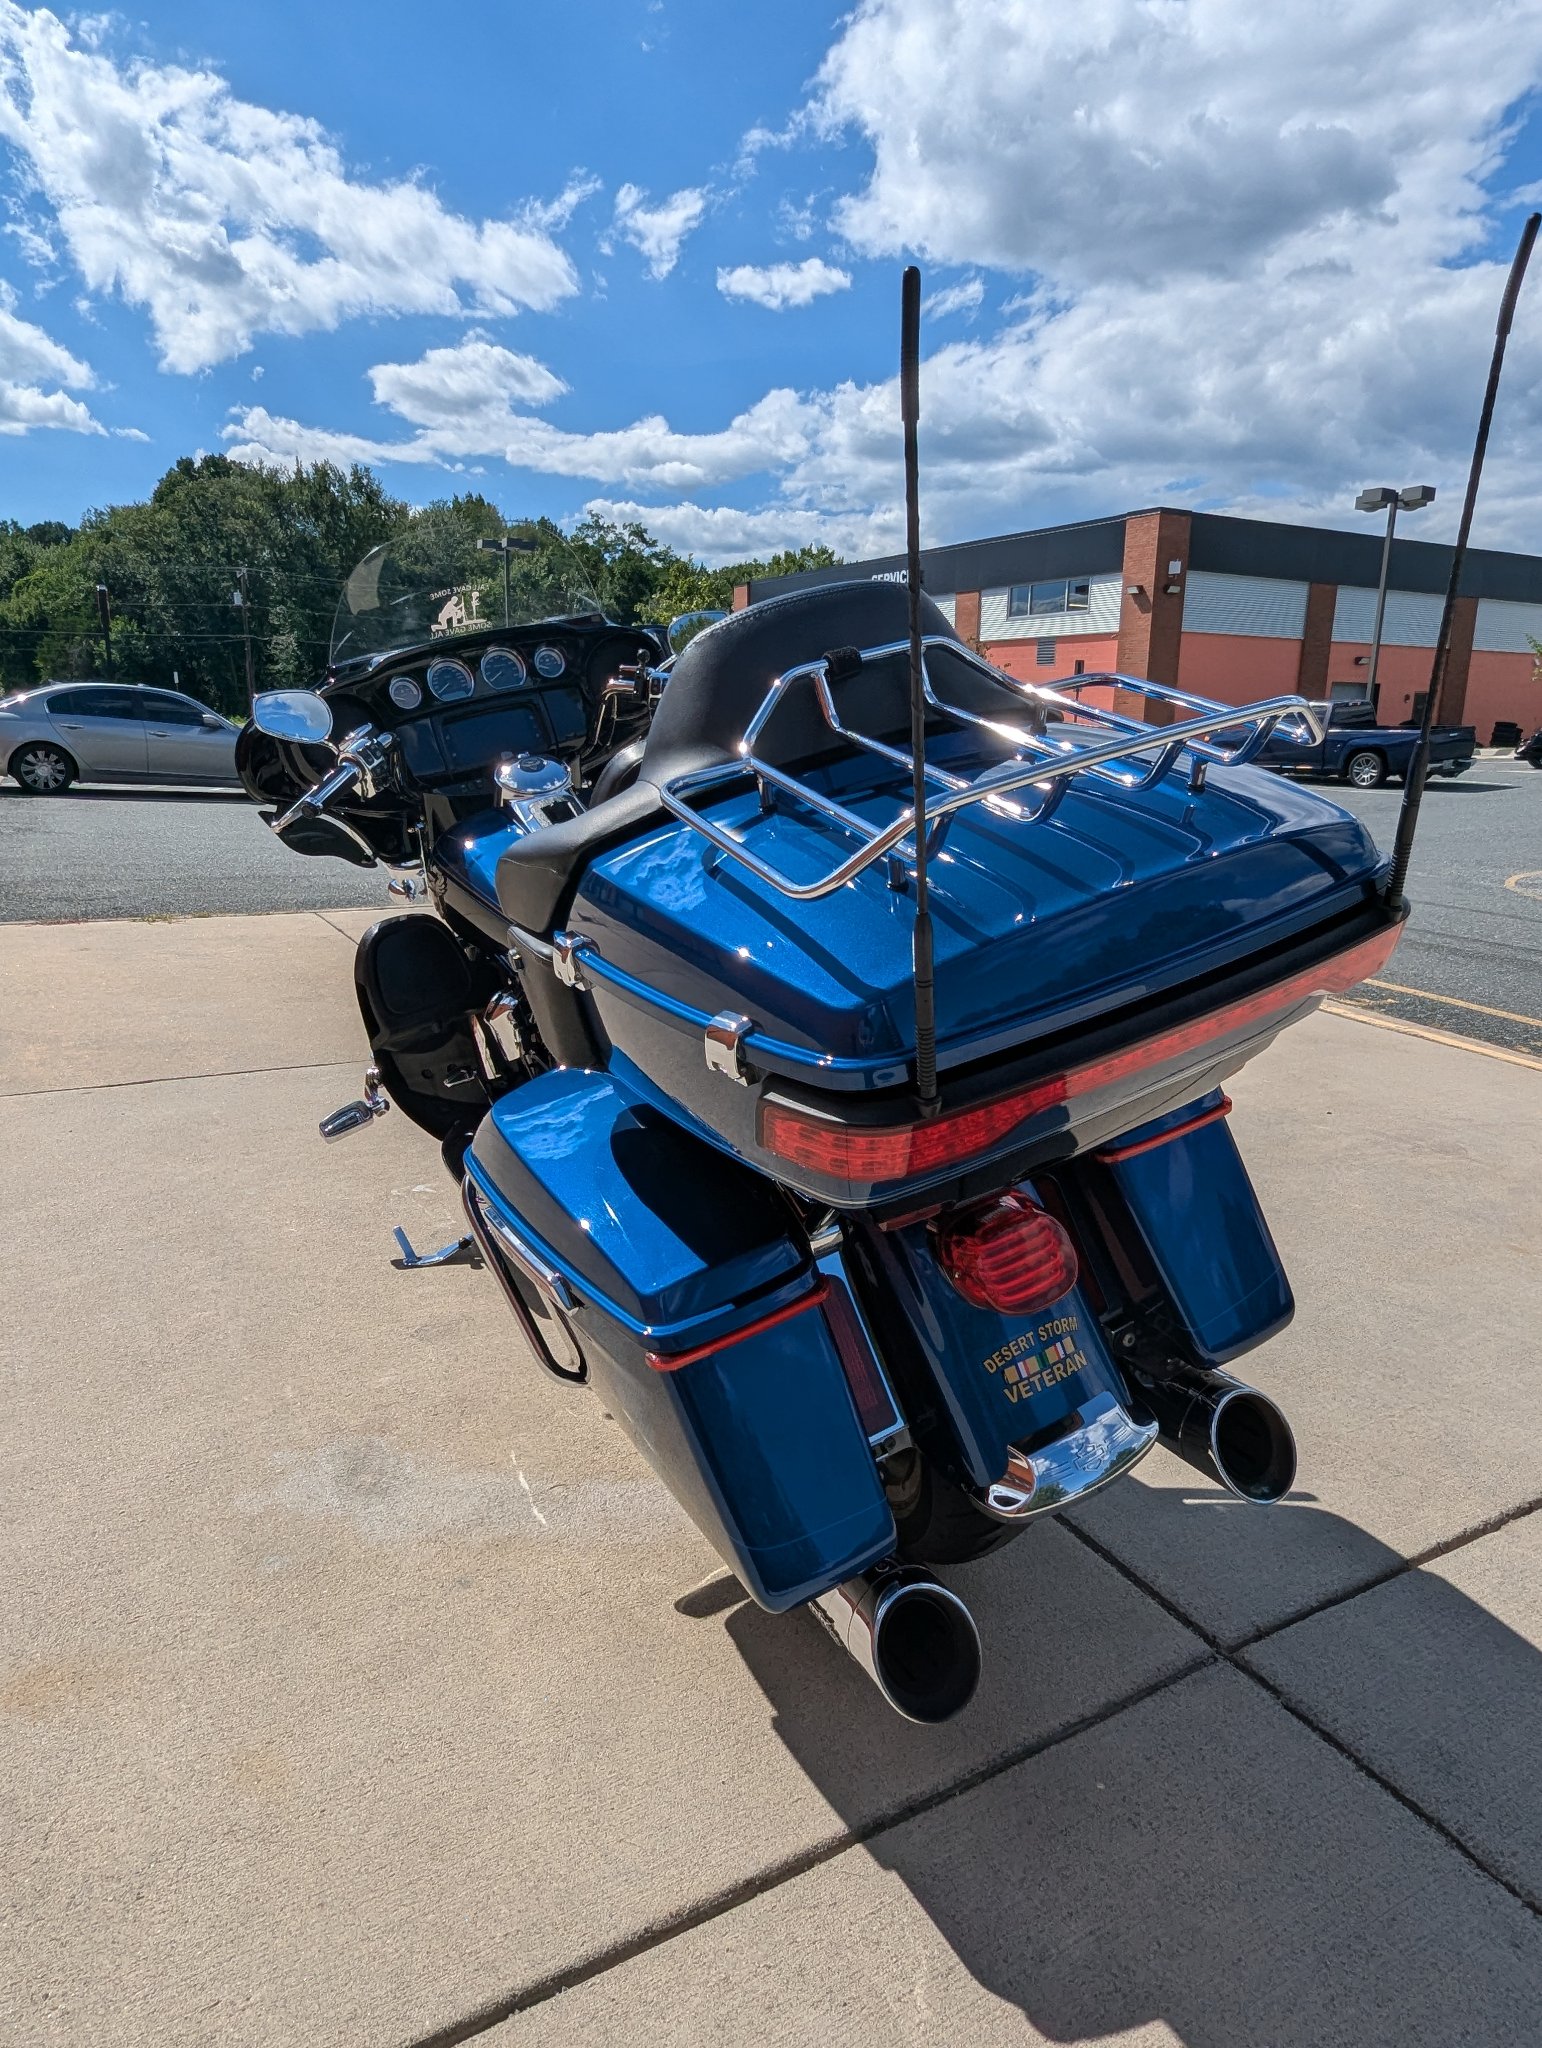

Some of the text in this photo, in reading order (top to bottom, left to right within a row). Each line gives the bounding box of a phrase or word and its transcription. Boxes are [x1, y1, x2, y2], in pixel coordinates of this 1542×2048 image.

[871, 569, 909, 583] SERVIC
[983, 1316, 1078, 1374] DESERT STORM
[1003, 1350, 1088, 1404] VETERAN
